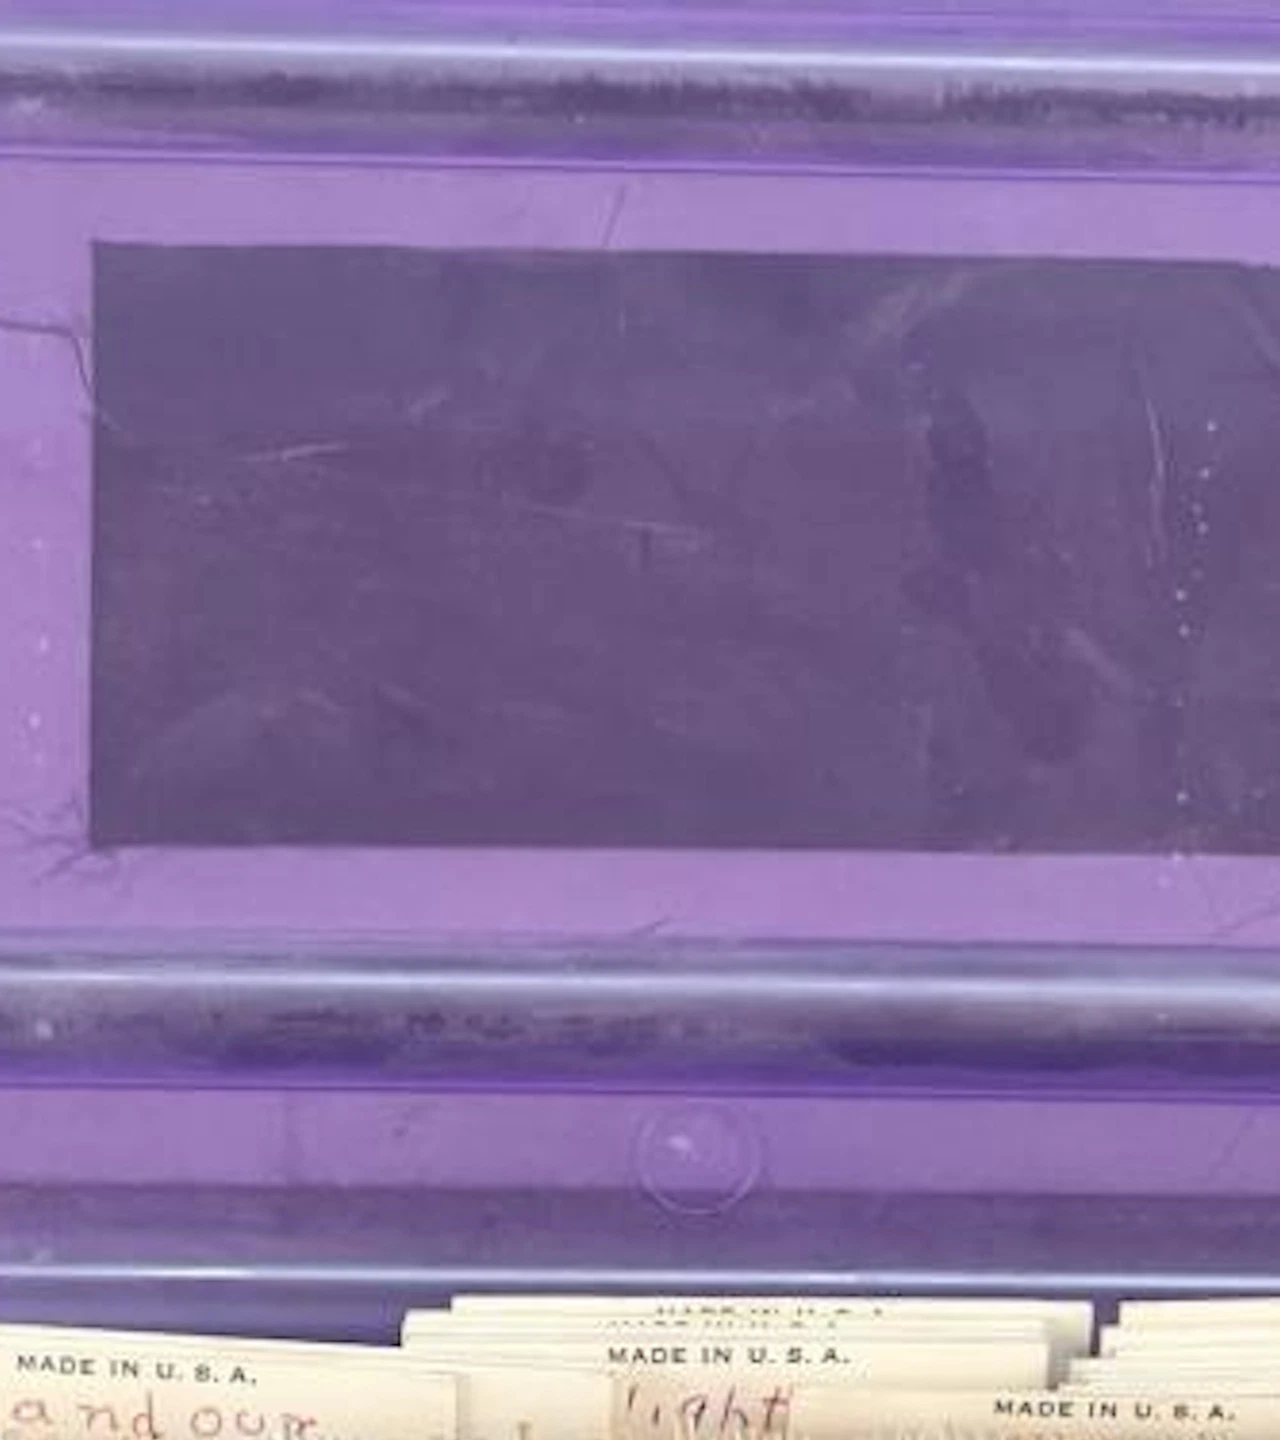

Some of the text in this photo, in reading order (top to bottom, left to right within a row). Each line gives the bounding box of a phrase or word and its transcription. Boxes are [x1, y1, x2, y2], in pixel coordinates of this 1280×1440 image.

[608, 1347, 687, 1364] MADE
[701, 1347, 732, 1364] IN
[16, 1355, 96, 1376] MADE
[109, 1359, 139, 1379] IN
[993, 1400, 1075, 1418] MADE
[1087, 1401, 1118, 1418] IN
